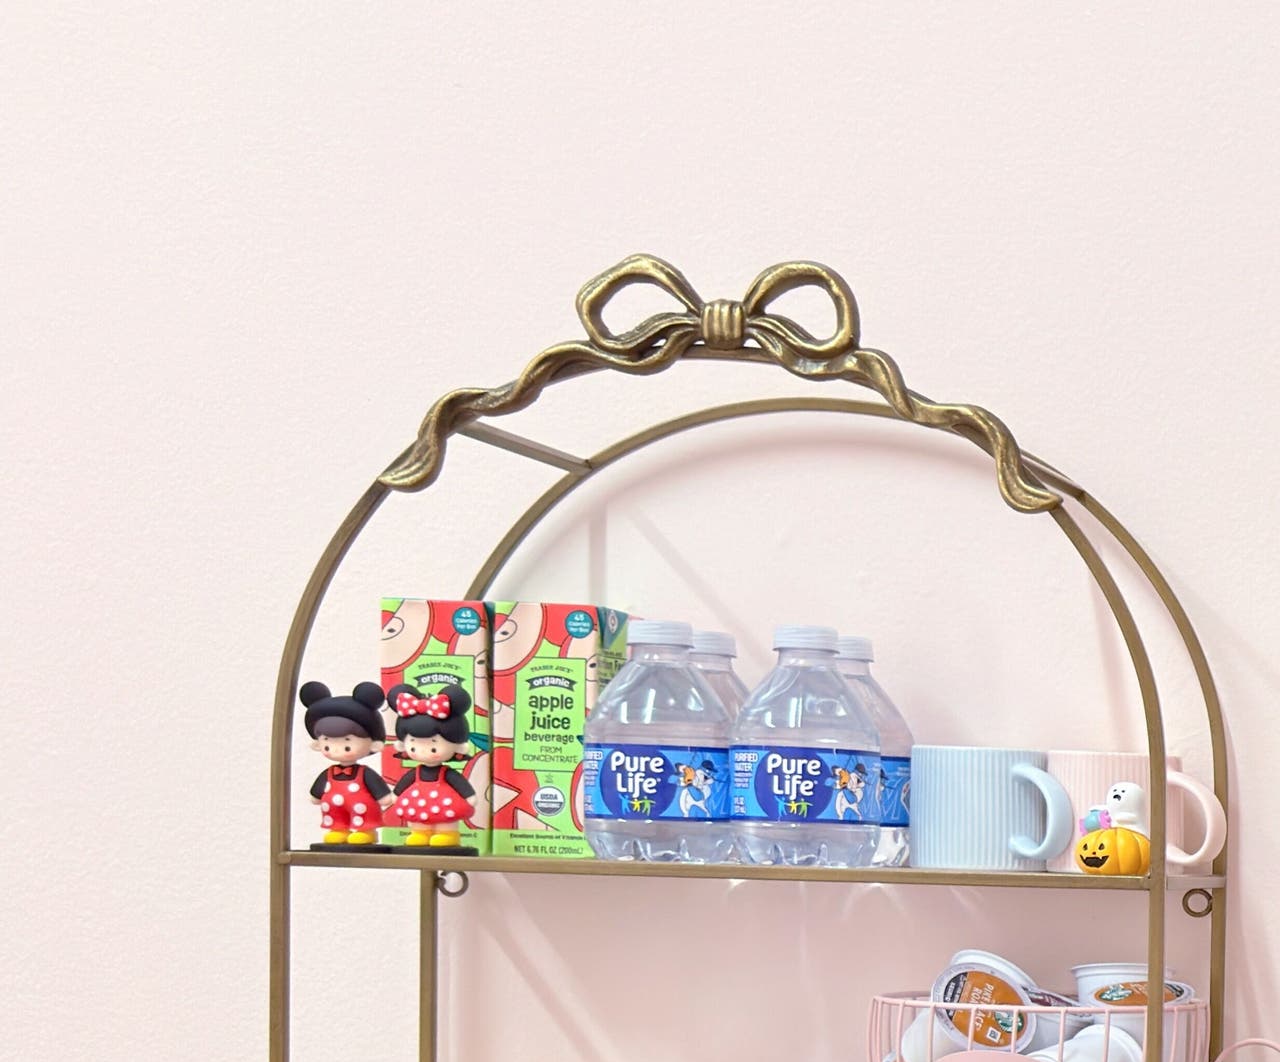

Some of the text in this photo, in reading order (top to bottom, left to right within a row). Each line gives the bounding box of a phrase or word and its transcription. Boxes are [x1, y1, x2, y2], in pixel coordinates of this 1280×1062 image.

[421, 674, 458, 684] organic
[532, 676, 570, 687] organic
[528, 694, 574, 712] apple
[530, 711, 571, 730] juice
[524, 732, 574, 745] beverage
[522, 754, 578, 764] CONCENTRATE
[540, 746, 562, 754] FROM
[611, 751, 664, 773] Pure
[766, 753, 822, 776] Pure
[616, 773, 658, 800] Life
[772, 774, 814, 800] Life
